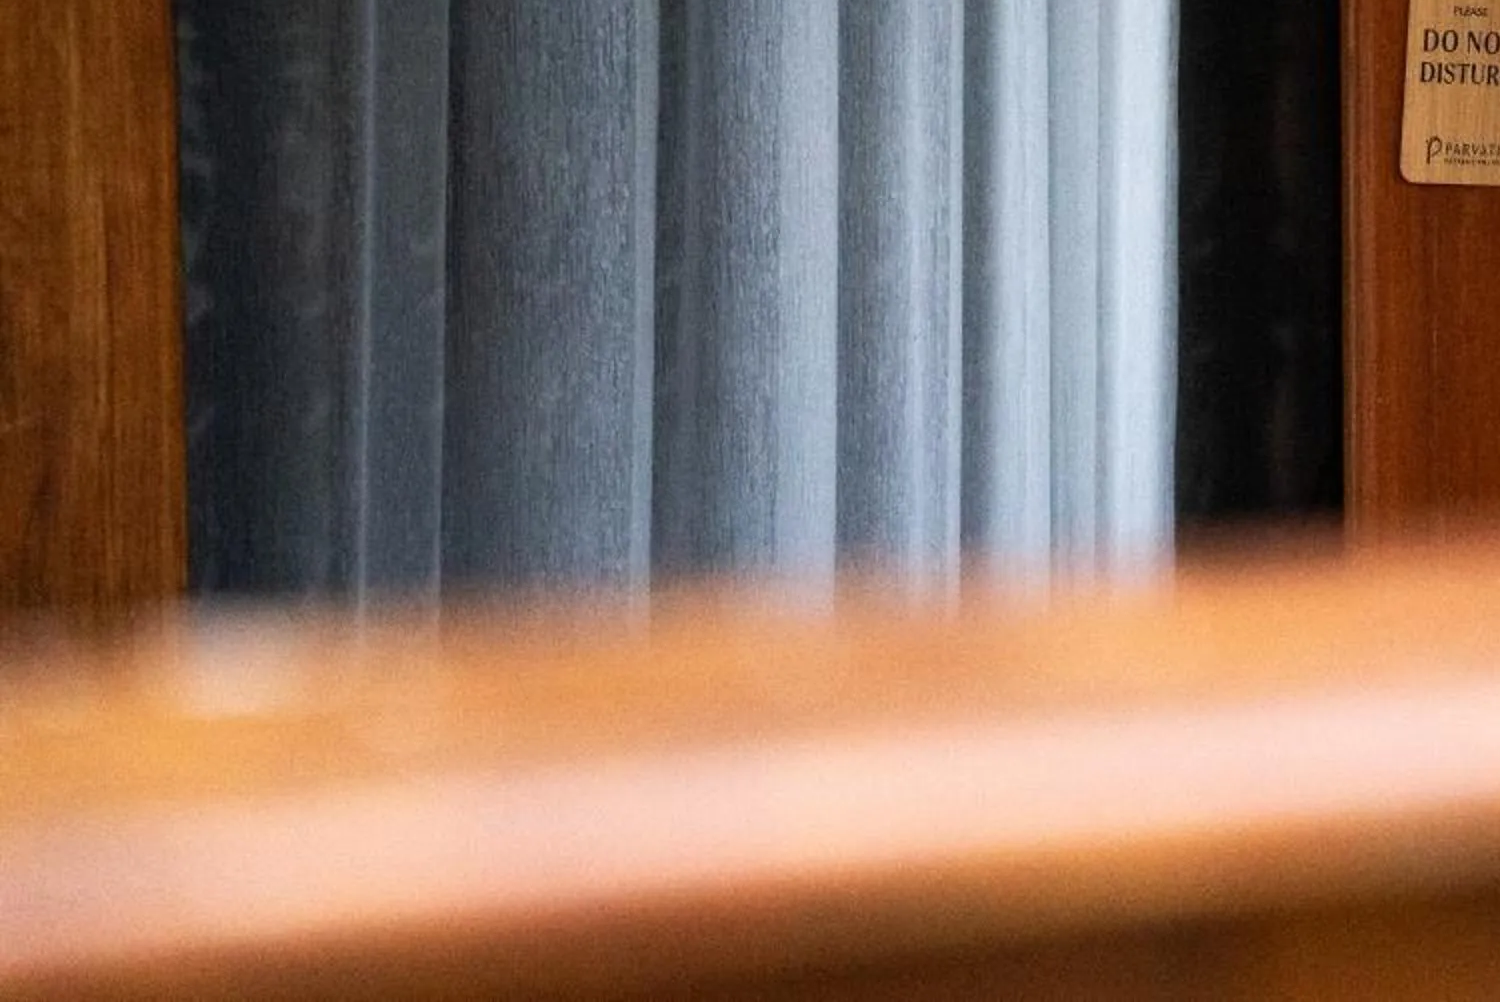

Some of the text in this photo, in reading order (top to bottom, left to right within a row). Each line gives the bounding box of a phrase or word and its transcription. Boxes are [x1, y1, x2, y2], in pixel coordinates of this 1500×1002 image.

[1453, 5, 1488, 17] PLEASE
[1423, 28, 1459, 53] DO
[1445, 141, 1500, 156] PARVATI
